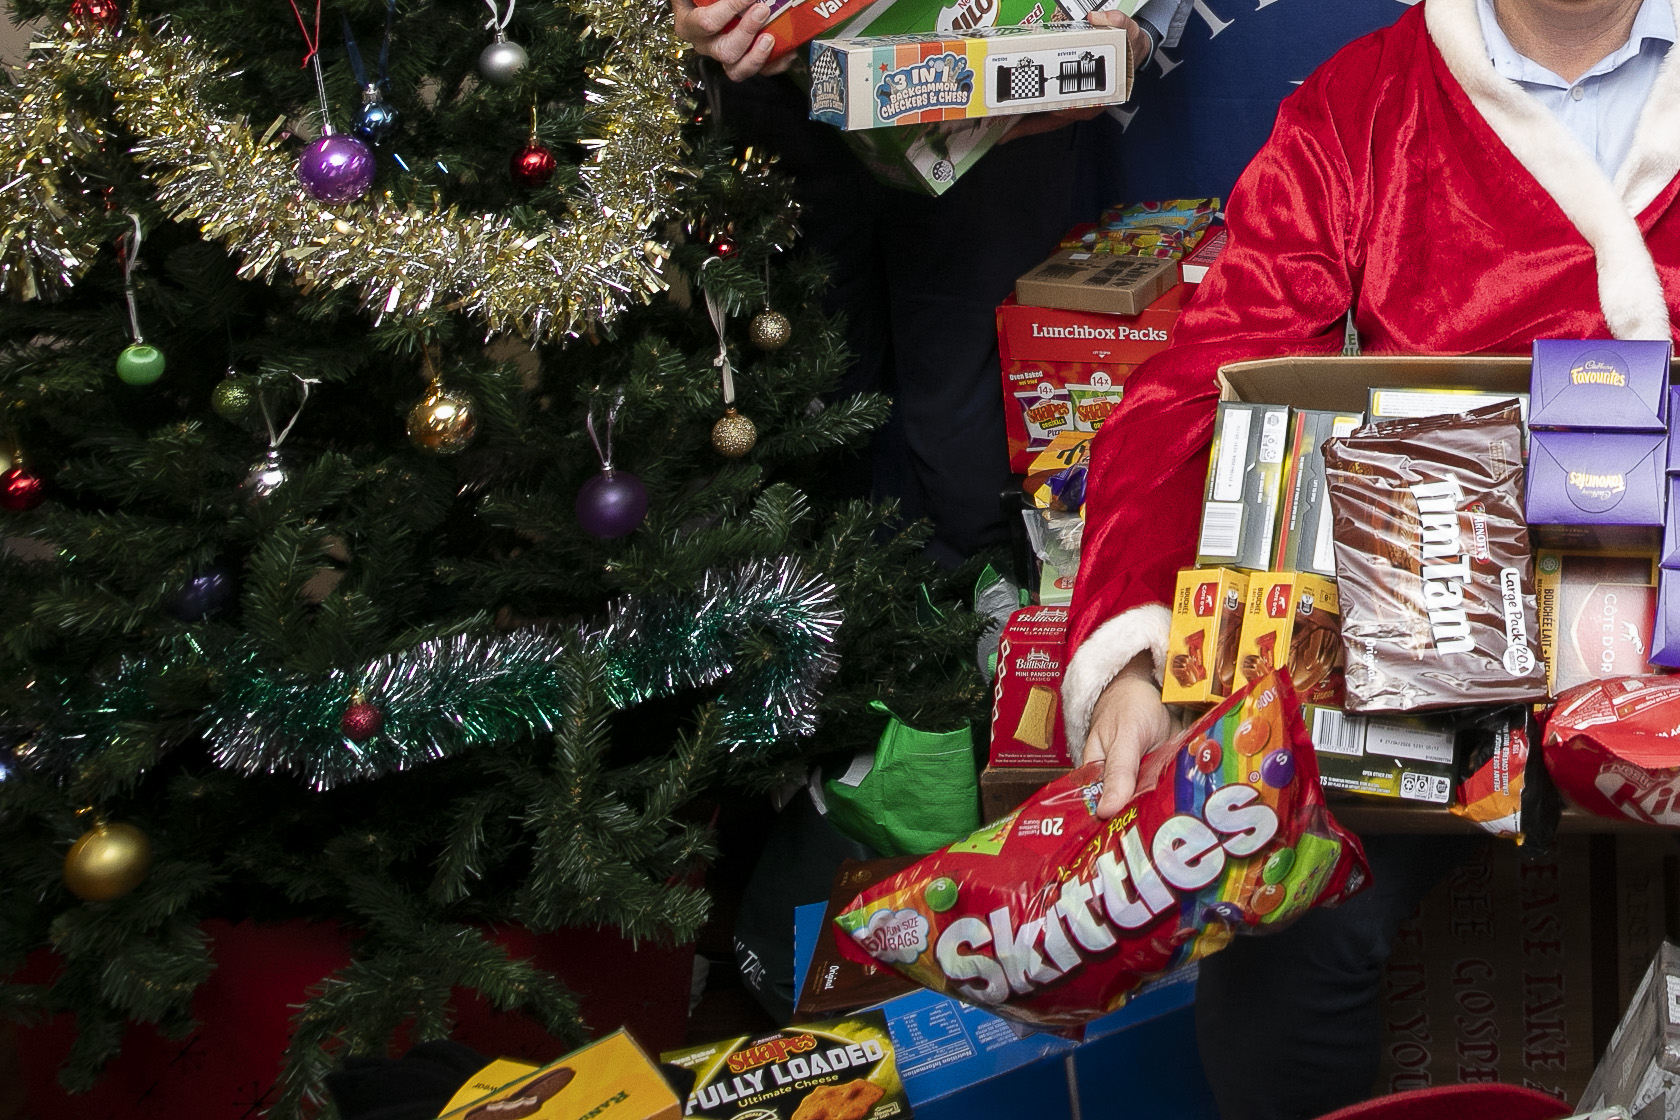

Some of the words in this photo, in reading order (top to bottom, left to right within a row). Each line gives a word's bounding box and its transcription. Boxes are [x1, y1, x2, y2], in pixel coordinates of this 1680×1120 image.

[894, 70, 907, 88] 3
[911, 68, 934, 84] IN
[890, 81, 960, 104] BACKGAMMON
[881, 97, 929, 118] CHECKERS
[939, 91, 968, 105] CHESS
[1031, 323, 1116, 339] Lunchbox
[1117, 326, 1168, 341] Packs
[1571, 366, 1625, 387] Favourites
[1585, 360, 1614, 371] Cadbury
[1038, 386, 1053, 394] 14x
[1091, 376, 1109, 386] 14x
[1570, 471, 1626, 493] Favourites
[1472, 515, 1489, 563] ARNOTT'S
[1180, 587, 1191, 616] BOUCHÉE
[1254, 587, 1264, 616] BOUCHÉE
[1503, 571, 1518, 610] Large
[1542, 588, 1557, 627] BOUCHÉE
[1602, 593, 1618, 632] CÔTE
[1509, 610, 1527, 646] Pack
[1541, 628, 1553, 648] LAIT
[1515, 646, 1530, 667] 20
[1600, 636, 1616, 673] D'OR
[1493, 755, 1501, 770] SOFT
[1502, 748, 1510, 771] COVERED
[1493, 771, 1501, 792] CREAMY
[1041, 816, 1065, 837] 20
[936, 785, 1279, 1007] Skittles
[885, 923, 900, 939] FUN
[901, 916, 919, 931] SIZE
[888, 930, 920, 951] BAGS
[686, 1069, 765, 1116] FULLY
[771, 1038, 884, 1086] LOADED
[738, 1085, 792, 1108] Ultimate
[795, 1073, 839, 1090] Cheese
